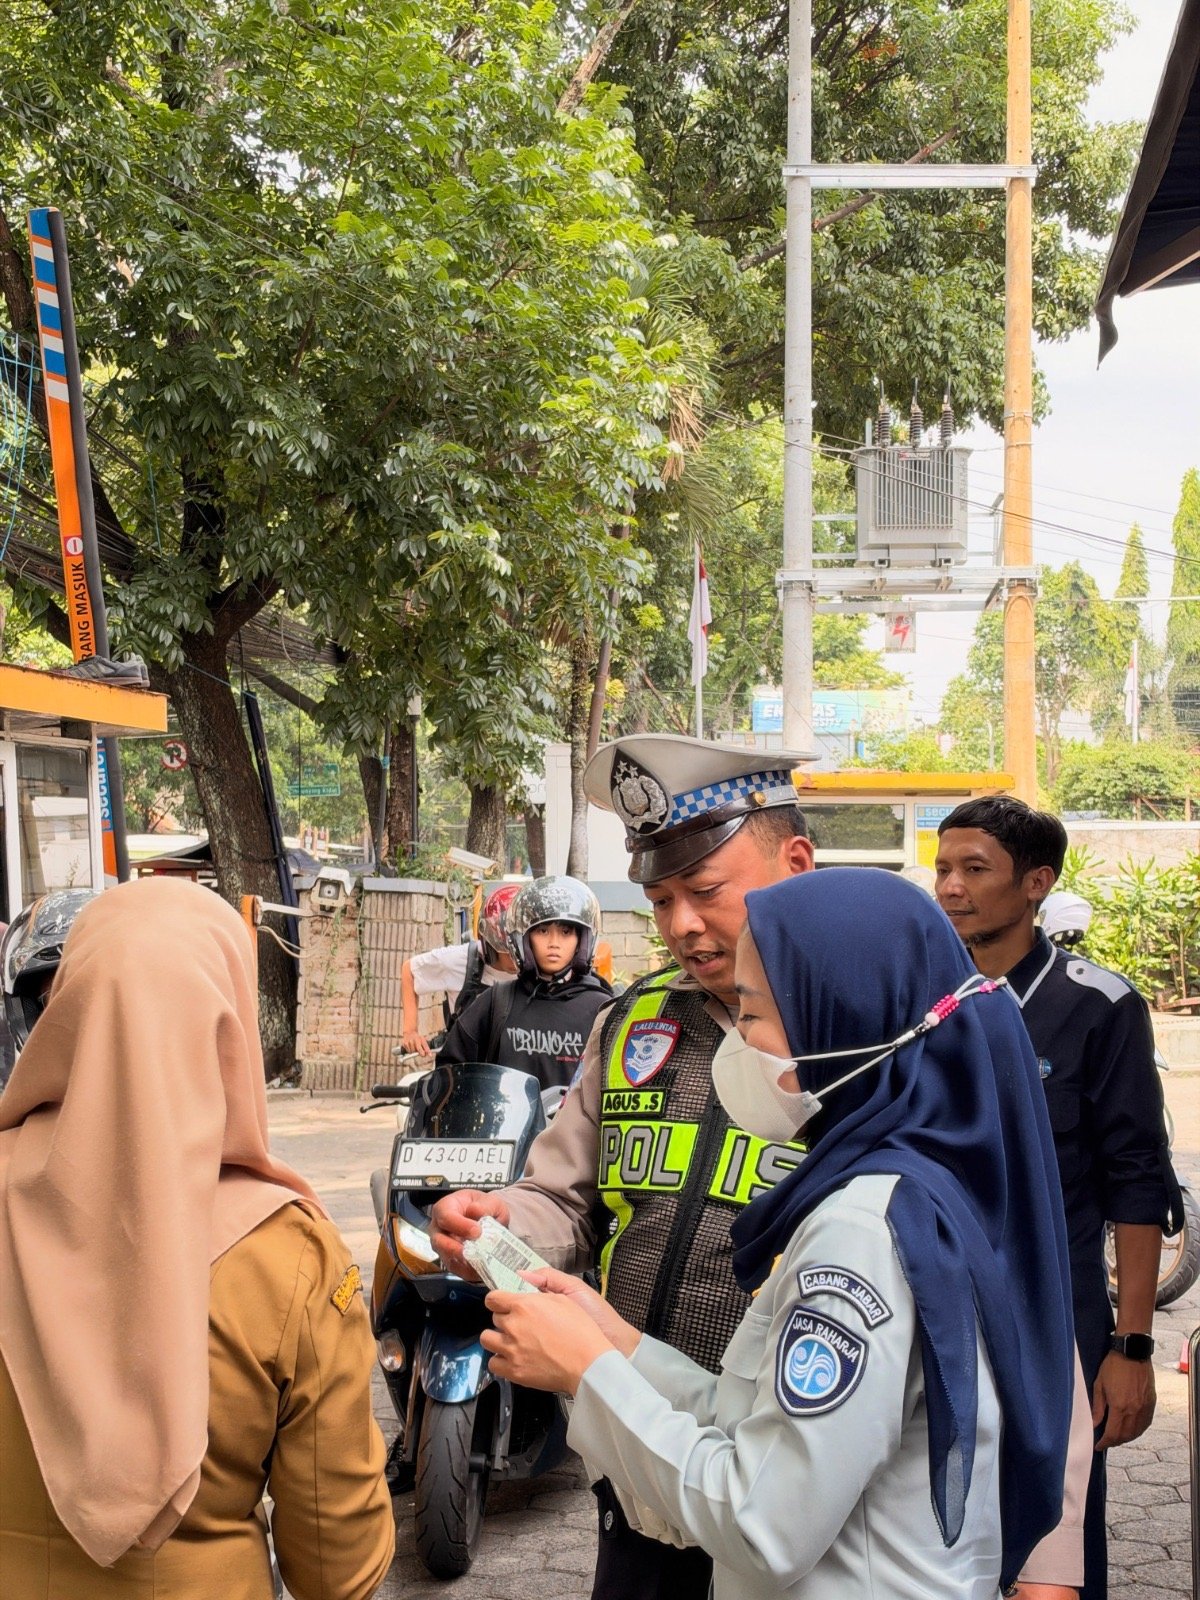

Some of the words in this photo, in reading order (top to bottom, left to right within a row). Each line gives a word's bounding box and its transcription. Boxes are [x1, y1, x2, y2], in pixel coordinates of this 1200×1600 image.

[71, 563, 88, 615] MASUK
[604, 1093, 641, 1112] AGUS
[403, 1146, 414, 1163] D
[424, 1146, 468, 1163] 4340
[475, 1147, 506, 1164] AEL
[600, 1124, 683, 1186] POL
[399, 1178, 423, 1187] YAMAHA
[805, 1273, 849, 1289] CABANG
[851, 1285, 882, 1319] JABAR
[792, 1317, 814, 1332] JASA
[814, 1322, 860, 1363] RAHARJA
